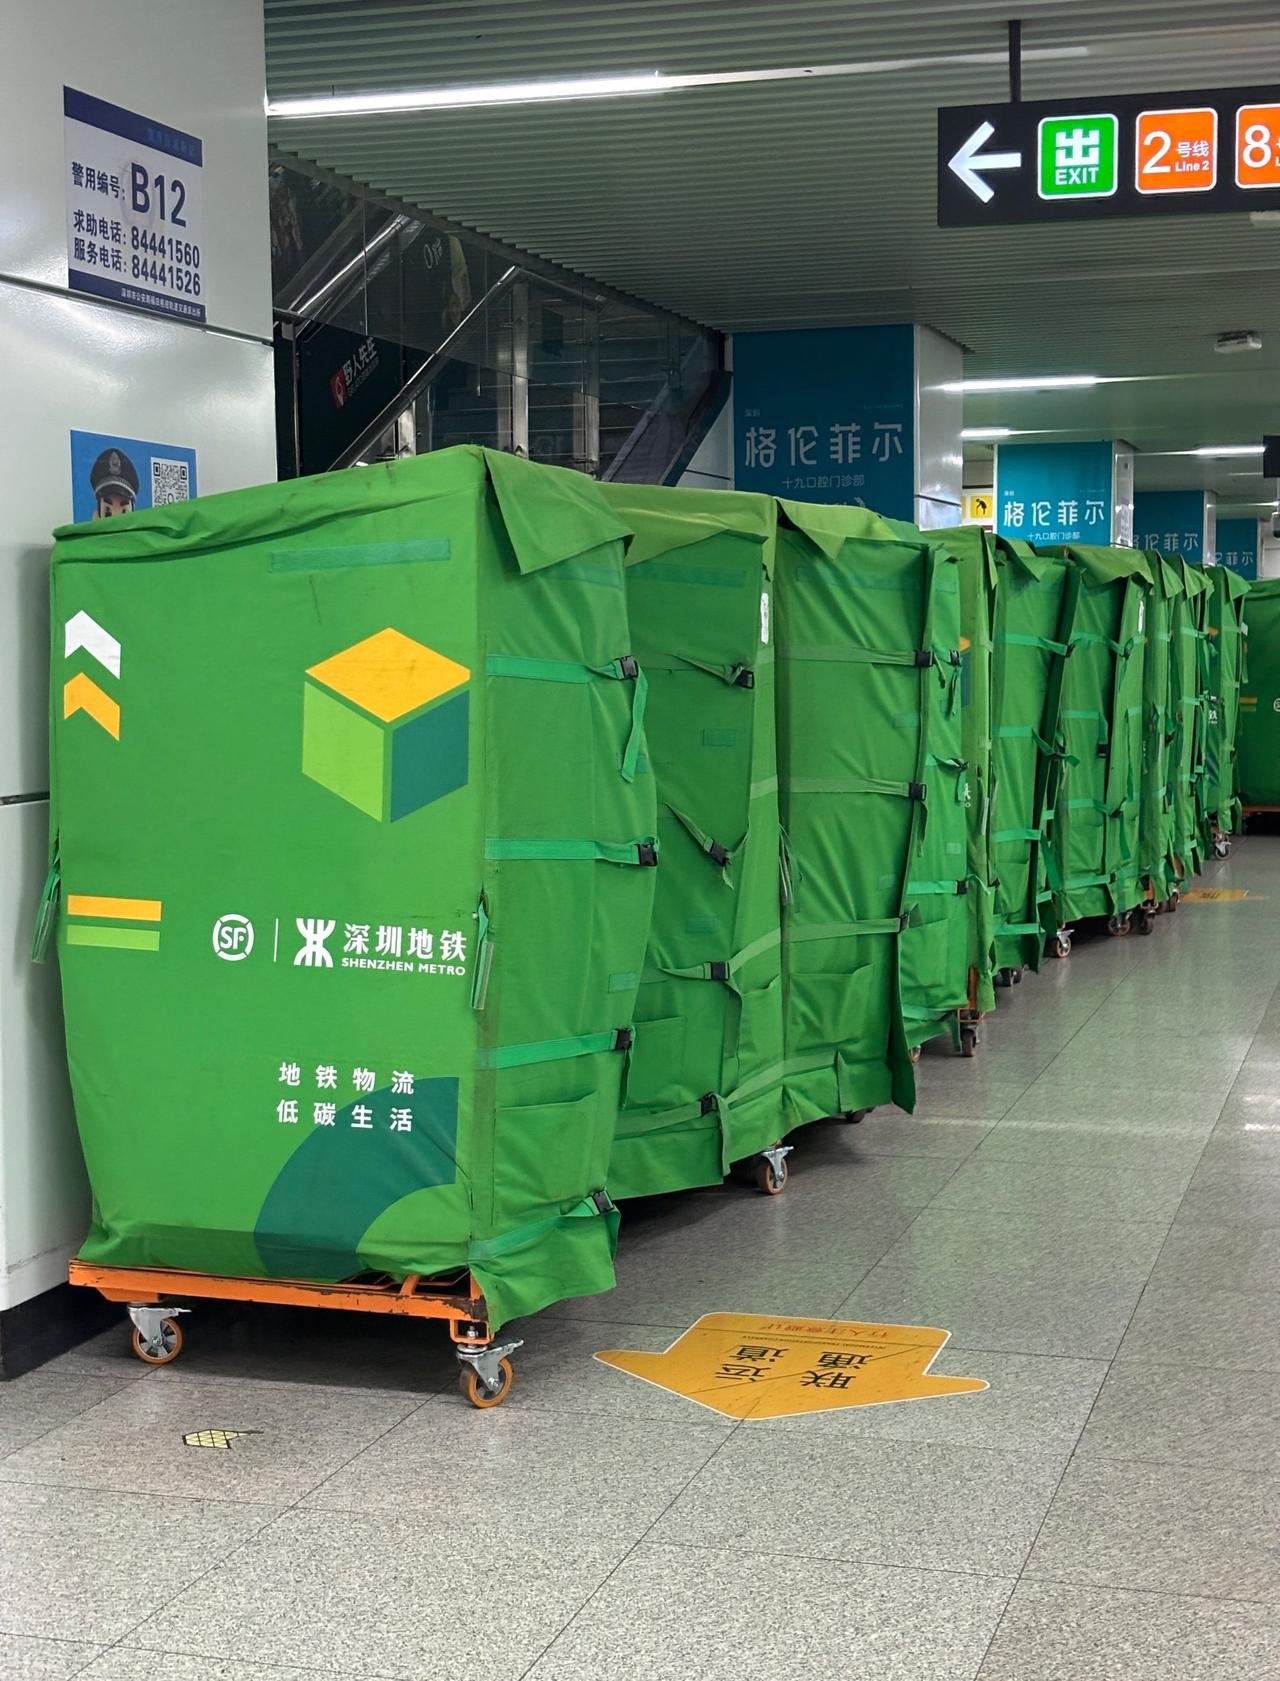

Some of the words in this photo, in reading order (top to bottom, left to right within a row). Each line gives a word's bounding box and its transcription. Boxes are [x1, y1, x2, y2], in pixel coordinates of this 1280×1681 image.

[1055, 128, 1100, 167] 出
[1142, 131, 1171, 174] 2
[1176, 140, 1209, 159] 号线
[1243, 124, 1272, 168] 8
[1055, 167, 1099, 186] EXIT
[1175, 161, 1199, 172] Line
[1200, 160, 1210, 171] 2
[131, 162, 187, 228] B12
[131, 226, 200, 269] 84441560
[131, 254, 201, 296] 84441526
[745, 422, 903, 468] 格伦菲尔
[782, 474, 865, 489] 十九口腔门诊部
[1003, 499, 1105, 527] 格伦菲尔
[220, 926, 247, 950] SF
[342, 922, 467, 962] 深圳地铁
[341, 957, 413, 972] SHENZHEN
[418, 963, 466, 976] METRO
[278, 1062, 415, 1095] 地铁物流
[276, 1098, 413, 1132] 低碳生活
